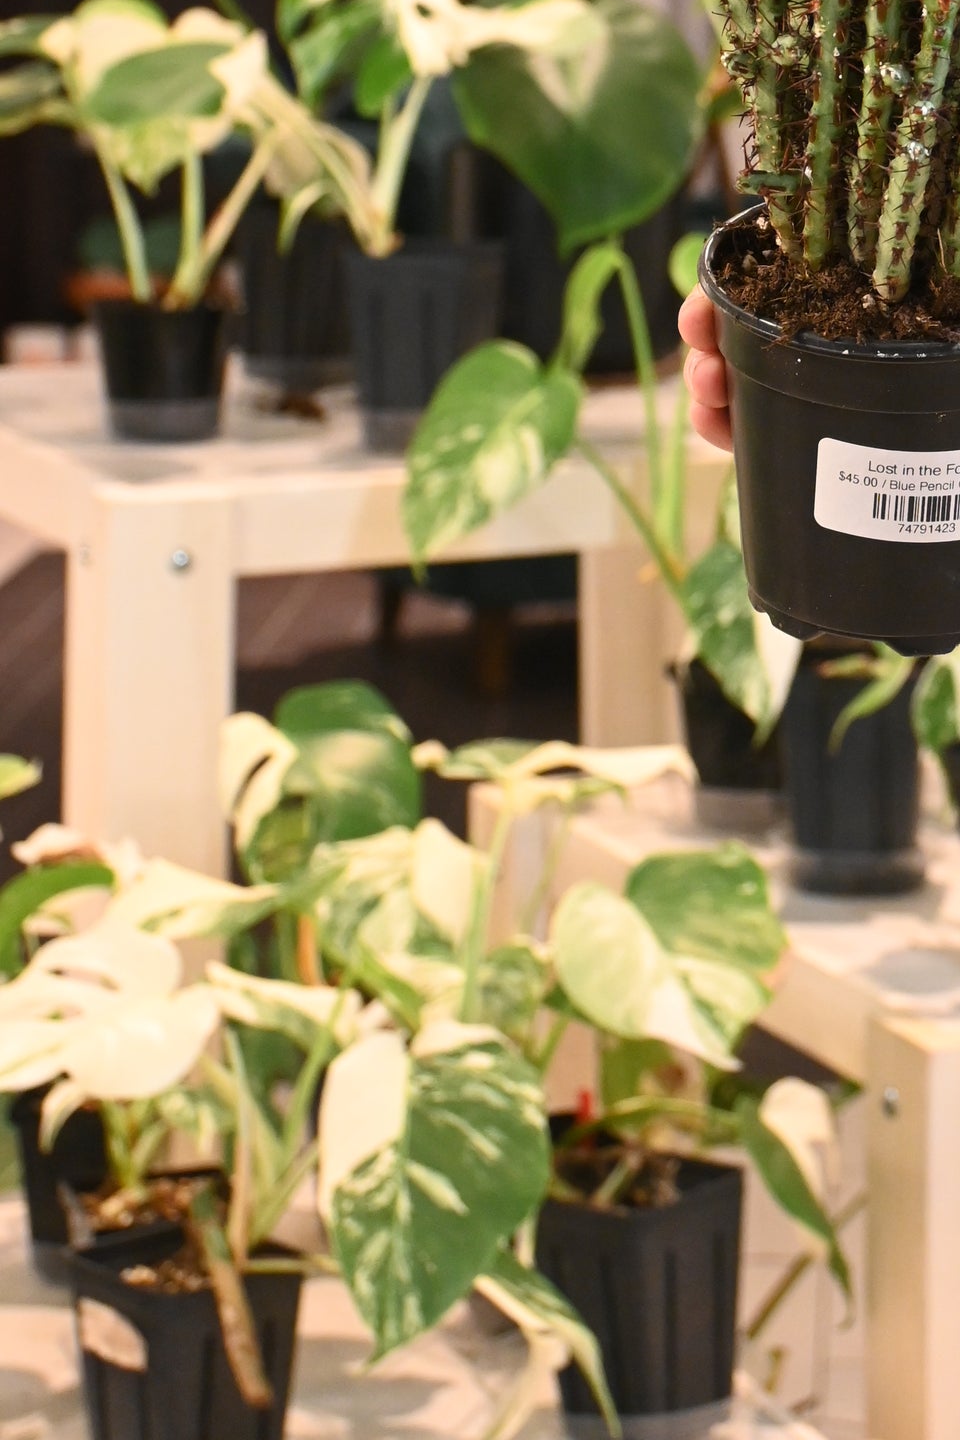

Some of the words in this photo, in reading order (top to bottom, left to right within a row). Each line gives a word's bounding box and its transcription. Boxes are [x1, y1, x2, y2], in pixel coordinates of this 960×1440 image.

[868, 460, 897, 474] Lost
[902, 464, 915, 476] in
[919, 465, 941, 476] the
[838, 470, 878, 488] $45.00
[889, 480, 916, 491] Blue
[919, 480, 955, 491] Pencil
[897, 522, 956, 534] 74791423
